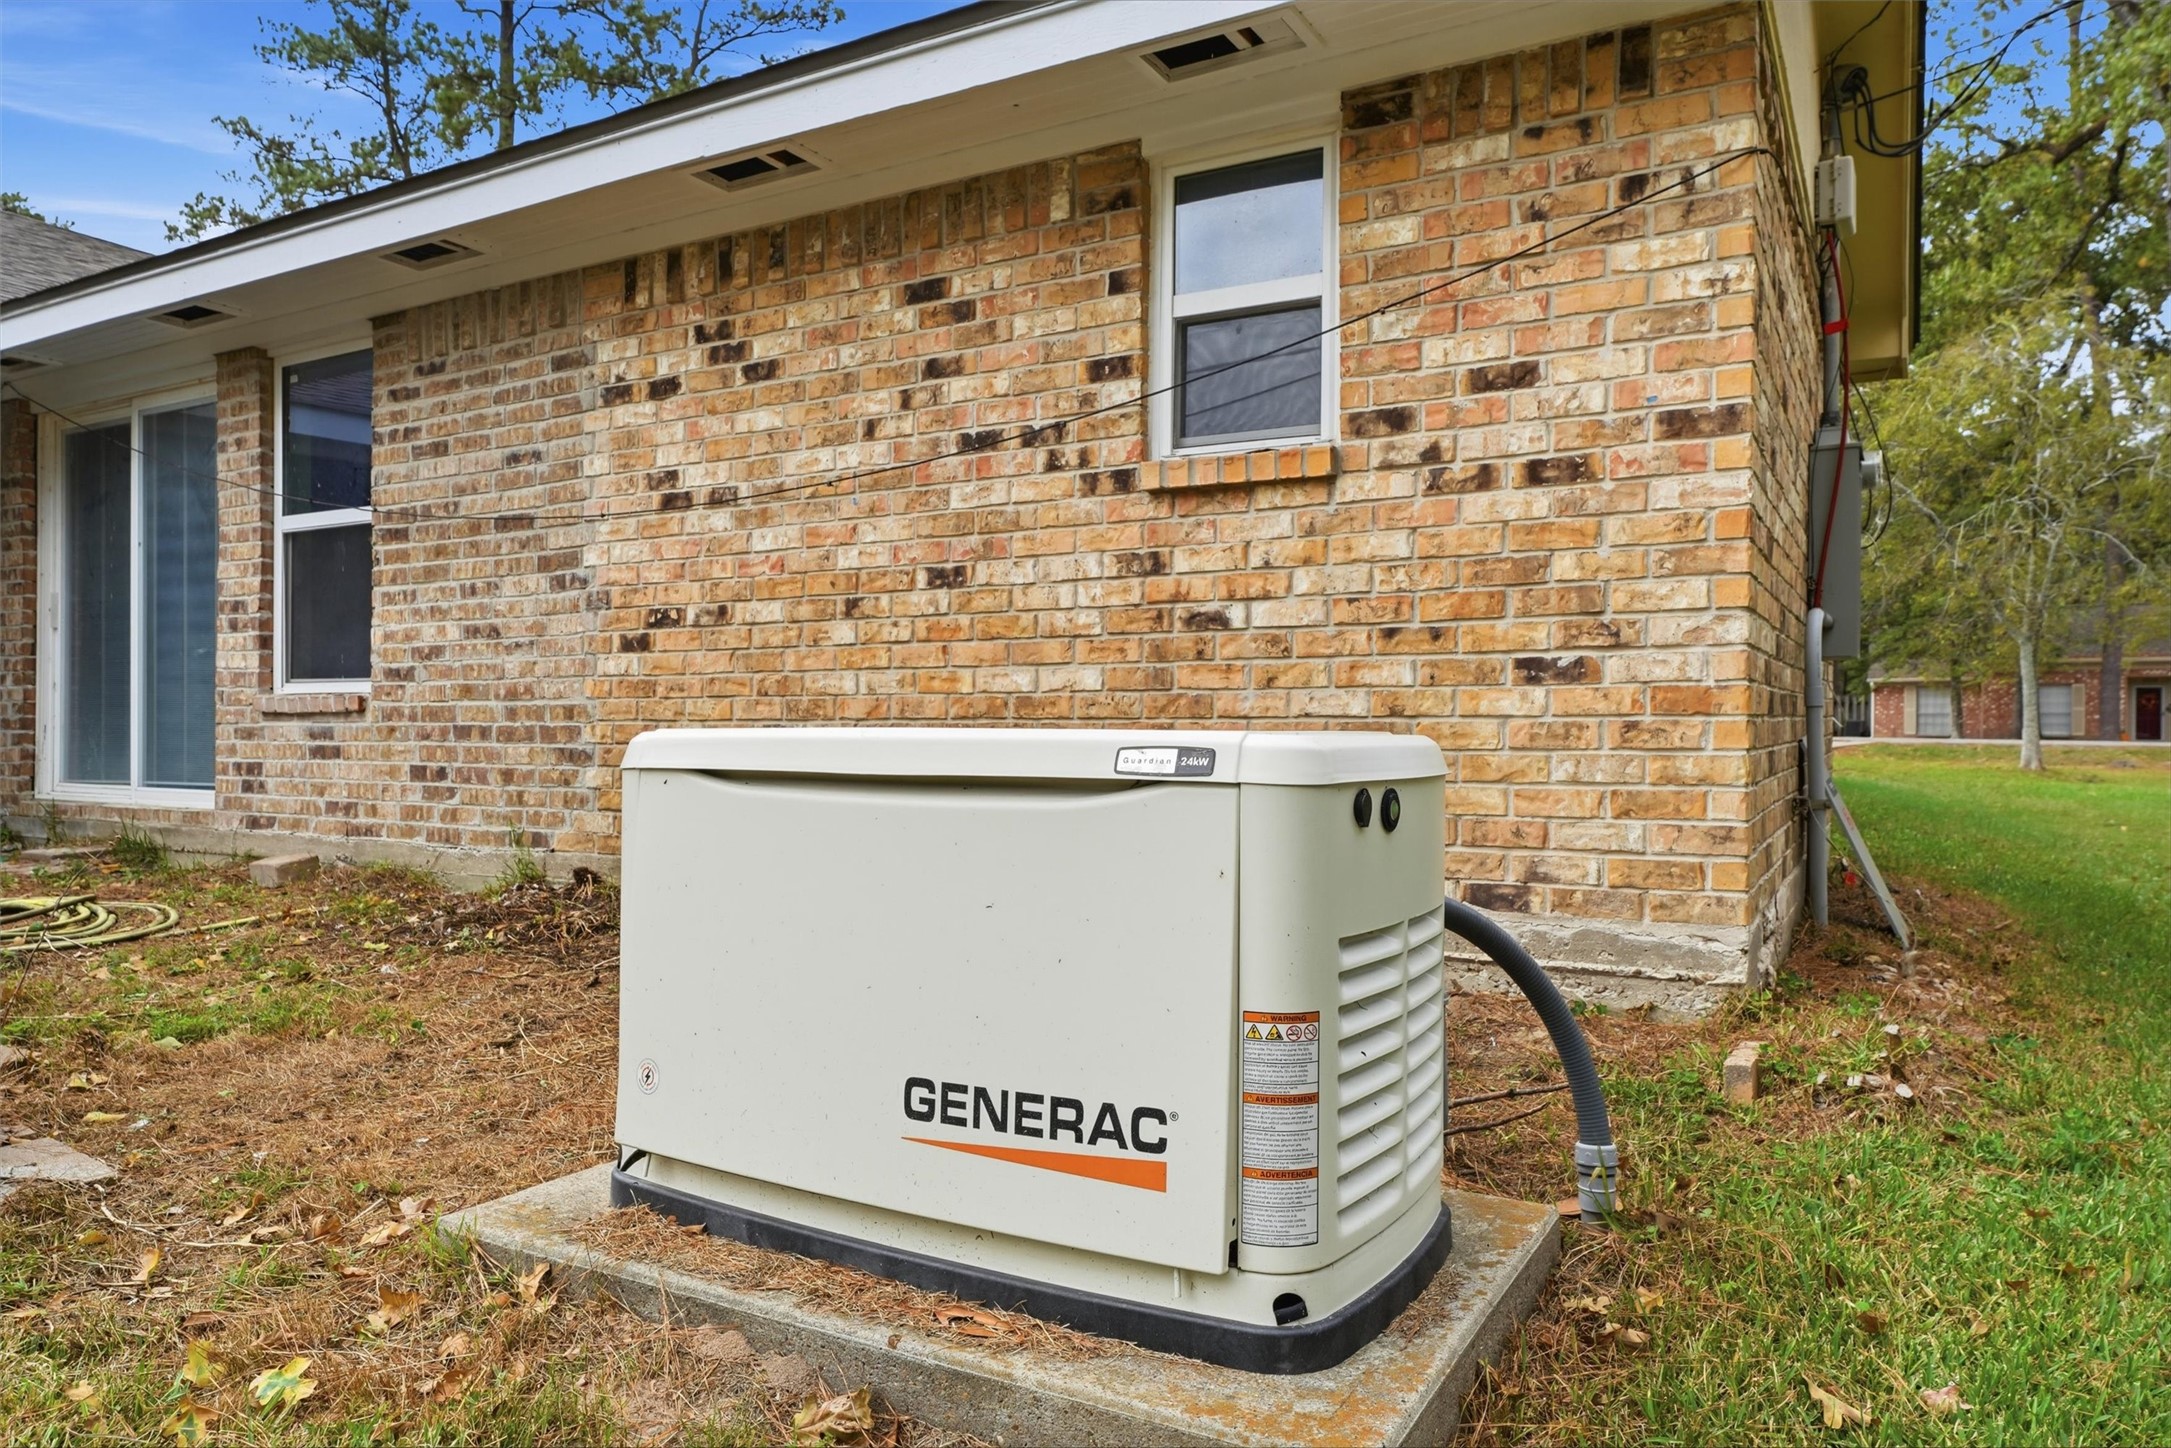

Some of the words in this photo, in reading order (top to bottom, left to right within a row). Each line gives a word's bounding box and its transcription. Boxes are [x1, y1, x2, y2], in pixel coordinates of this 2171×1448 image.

[1122, 756, 1172, 765] Guardian
[1180, 756, 1210, 767] 24kW
[1270, 1014, 1307, 1022] WARNING
[1255, 1094, 1317, 1104] AVERTISSEMENT
[903, 1076, 1168, 1154] GENERAC
[1260, 1170, 1313, 1179] ADVERTENCIA
